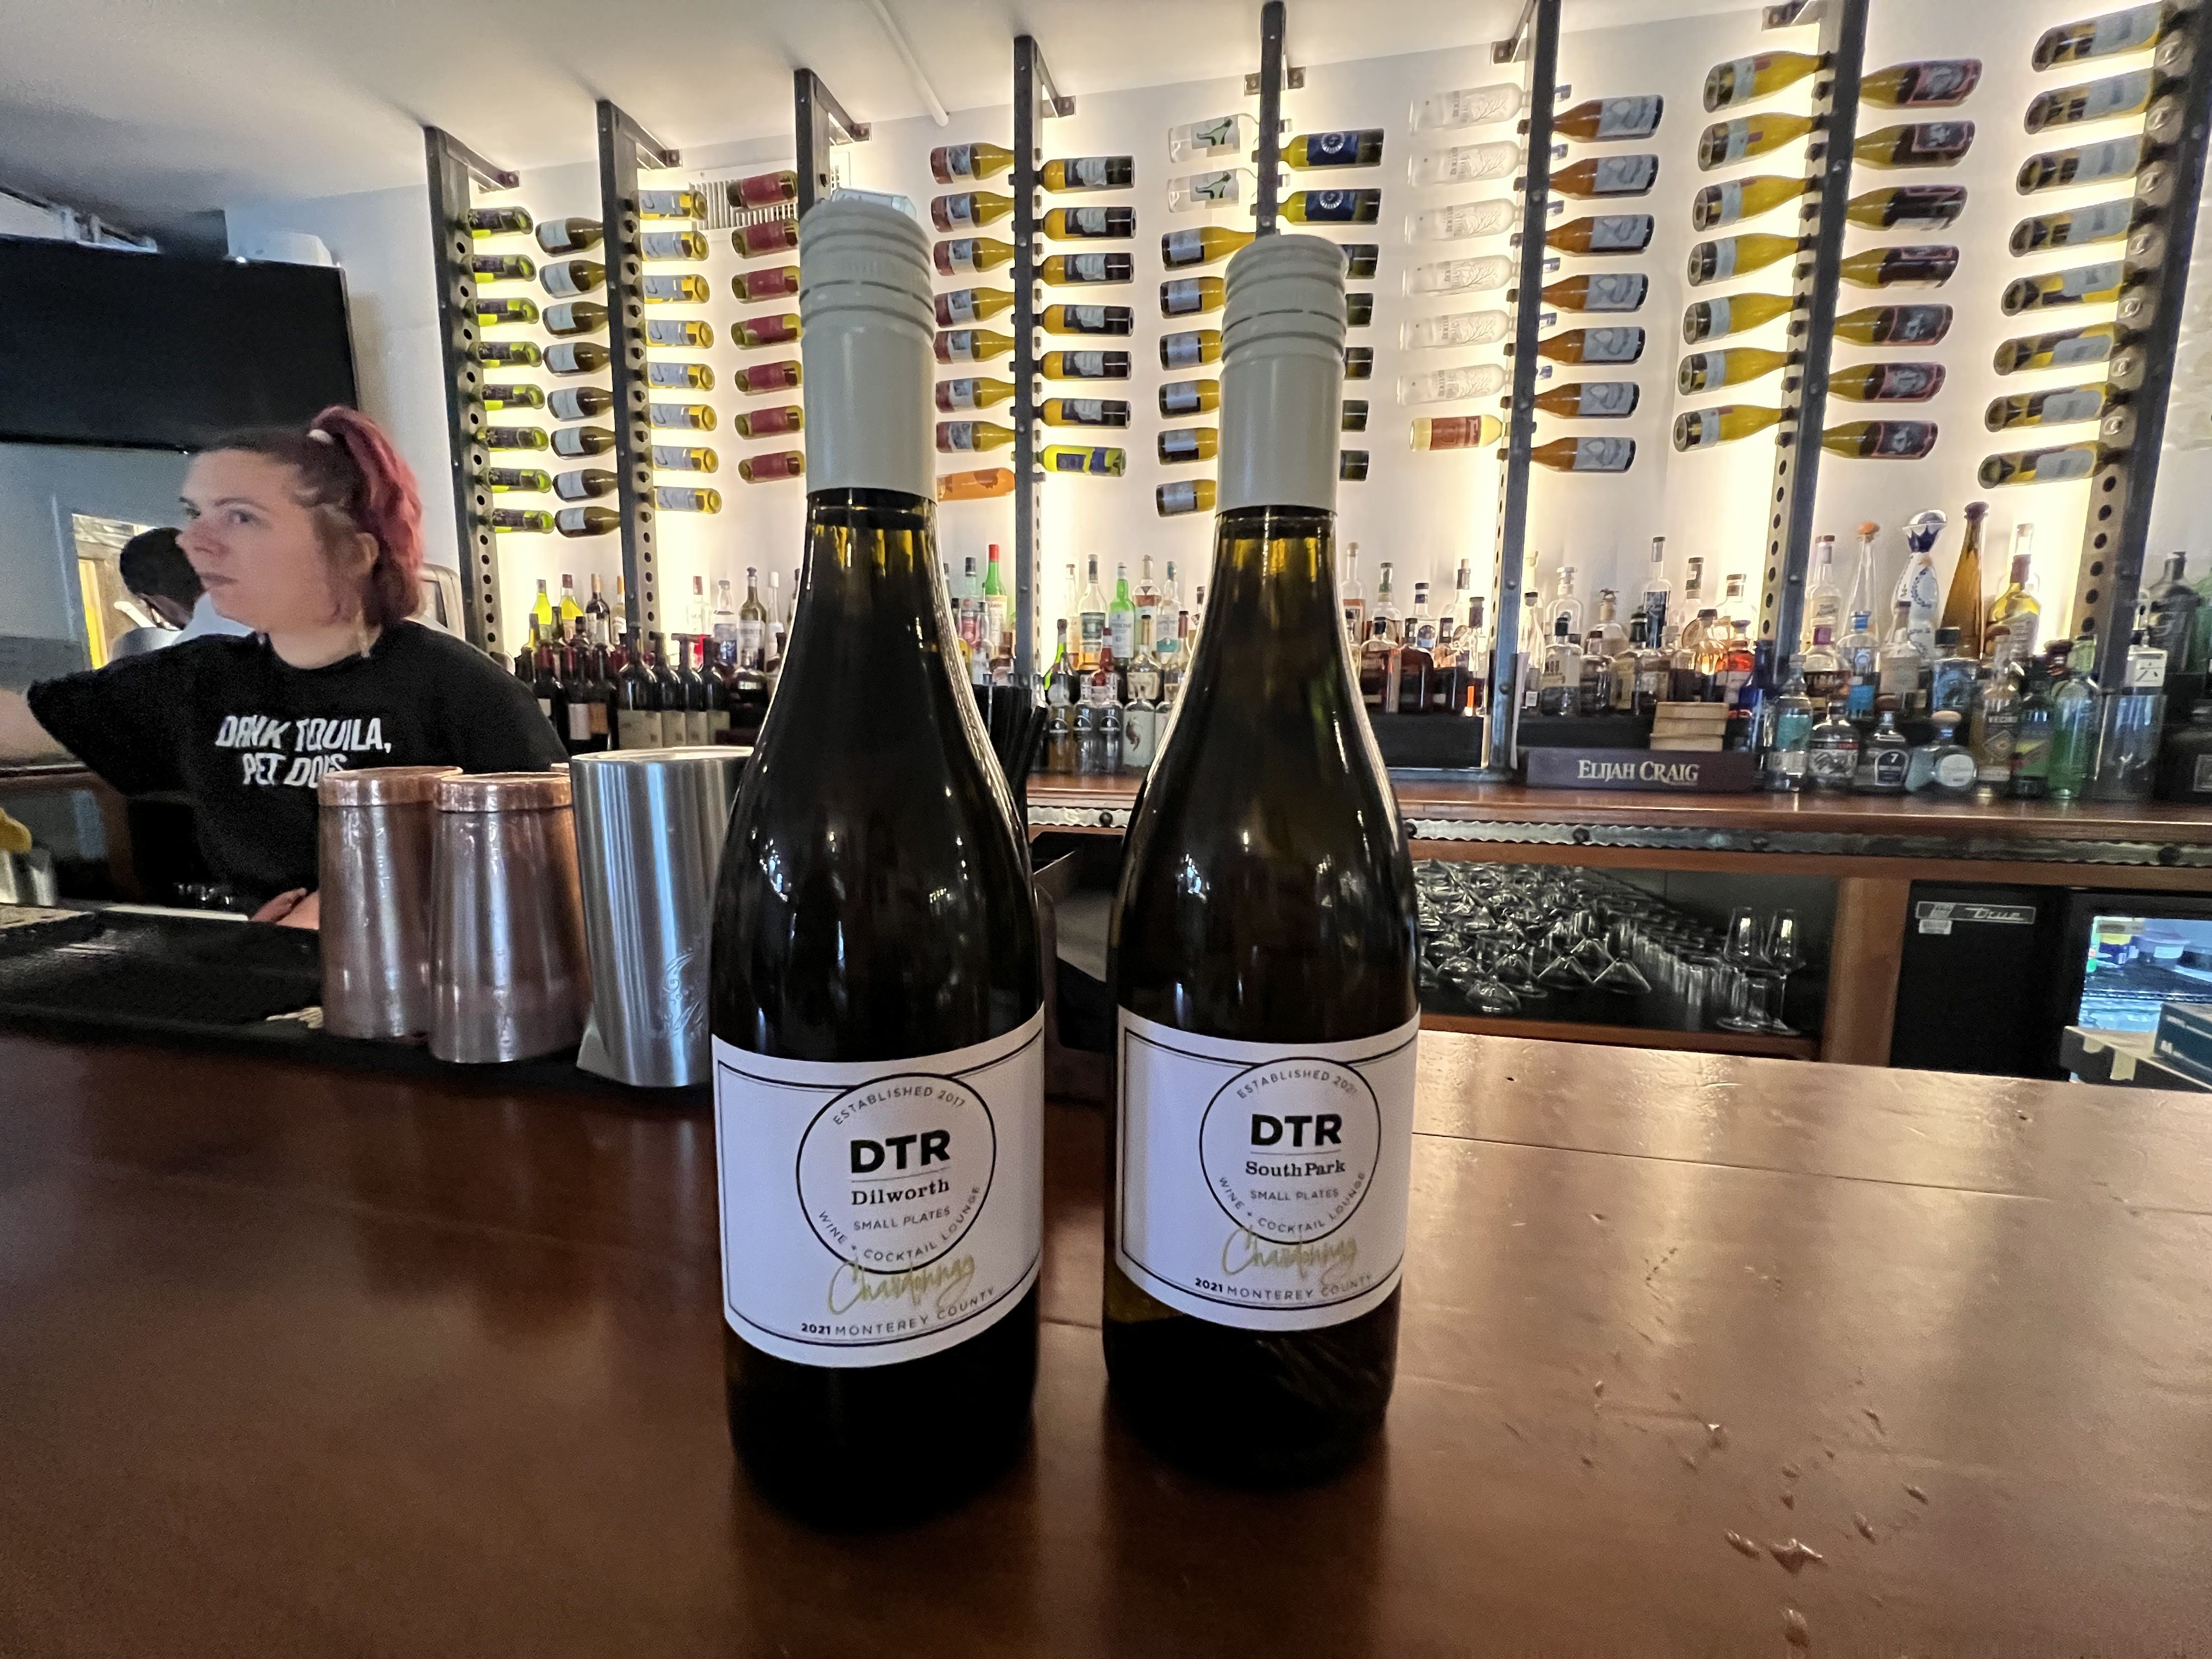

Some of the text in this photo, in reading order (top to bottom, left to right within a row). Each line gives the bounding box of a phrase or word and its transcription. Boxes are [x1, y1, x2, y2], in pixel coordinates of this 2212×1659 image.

[242, 752, 287, 786] PET
[1577, 759, 1700, 783] ELIJAH CRAIG
[1236, 1069, 1330, 1099] ESTABLISHED
[832, 1086, 966, 1125] ESTABLISHED 2017
[1251, 1113, 1342, 1147] DTR
[850, 1129, 951, 1174] DTR
[851, 1178, 950, 1205] Dilworth
[1219, 1177, 1245, 1210] WINE
[1258, 1217, 1326, 1234] COCKTAIL
[1328, 1171, 1366, 1221] LOUNGE
[1250, 1188, 1339, 1201] SMALL PLATES
[819, 1210, 848, 1245] WINE
[863, 1242, 938, 1262] COCKTAIL
[940, 1185, 981, 1241] LOUNGE
[853, 1206, 951, 1231] SMALL PLATES
[1194, 1273, 1373, 1300] 2021 MONTEREY COUNTY
[800, 1286, 995, 1336] 2021 MONTEREY COUNTY
